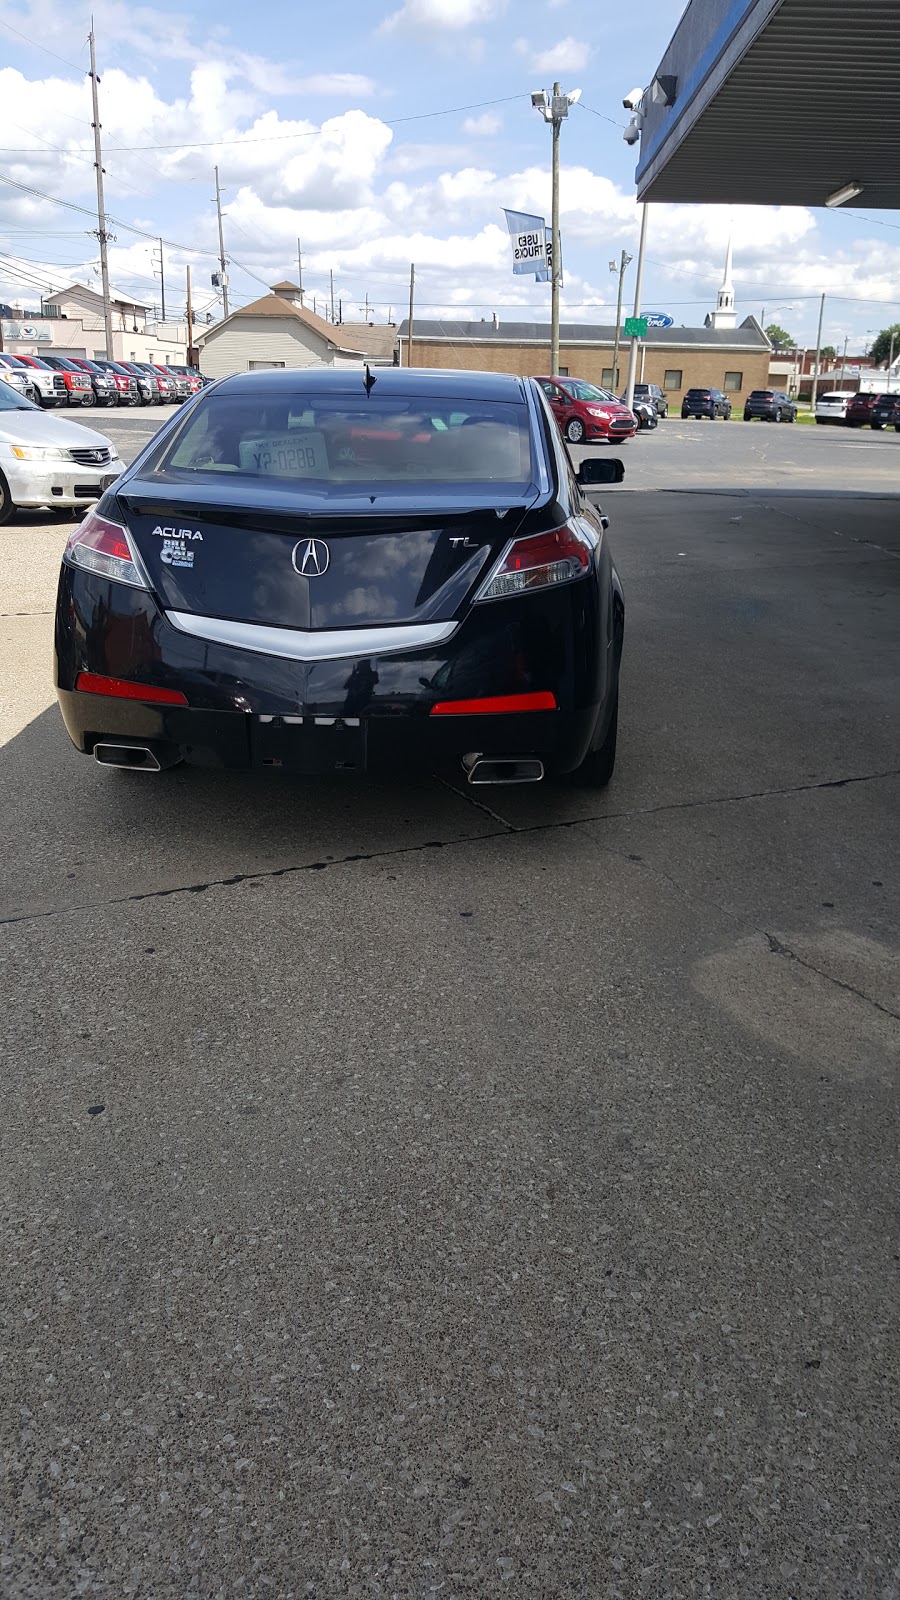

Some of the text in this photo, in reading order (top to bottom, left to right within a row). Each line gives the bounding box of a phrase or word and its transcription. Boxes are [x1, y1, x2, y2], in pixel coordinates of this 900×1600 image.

[152, 526, 203, 540] ACURA
[163, 539, 187, 551] BILL
[449, 537, 479, 549] TL
